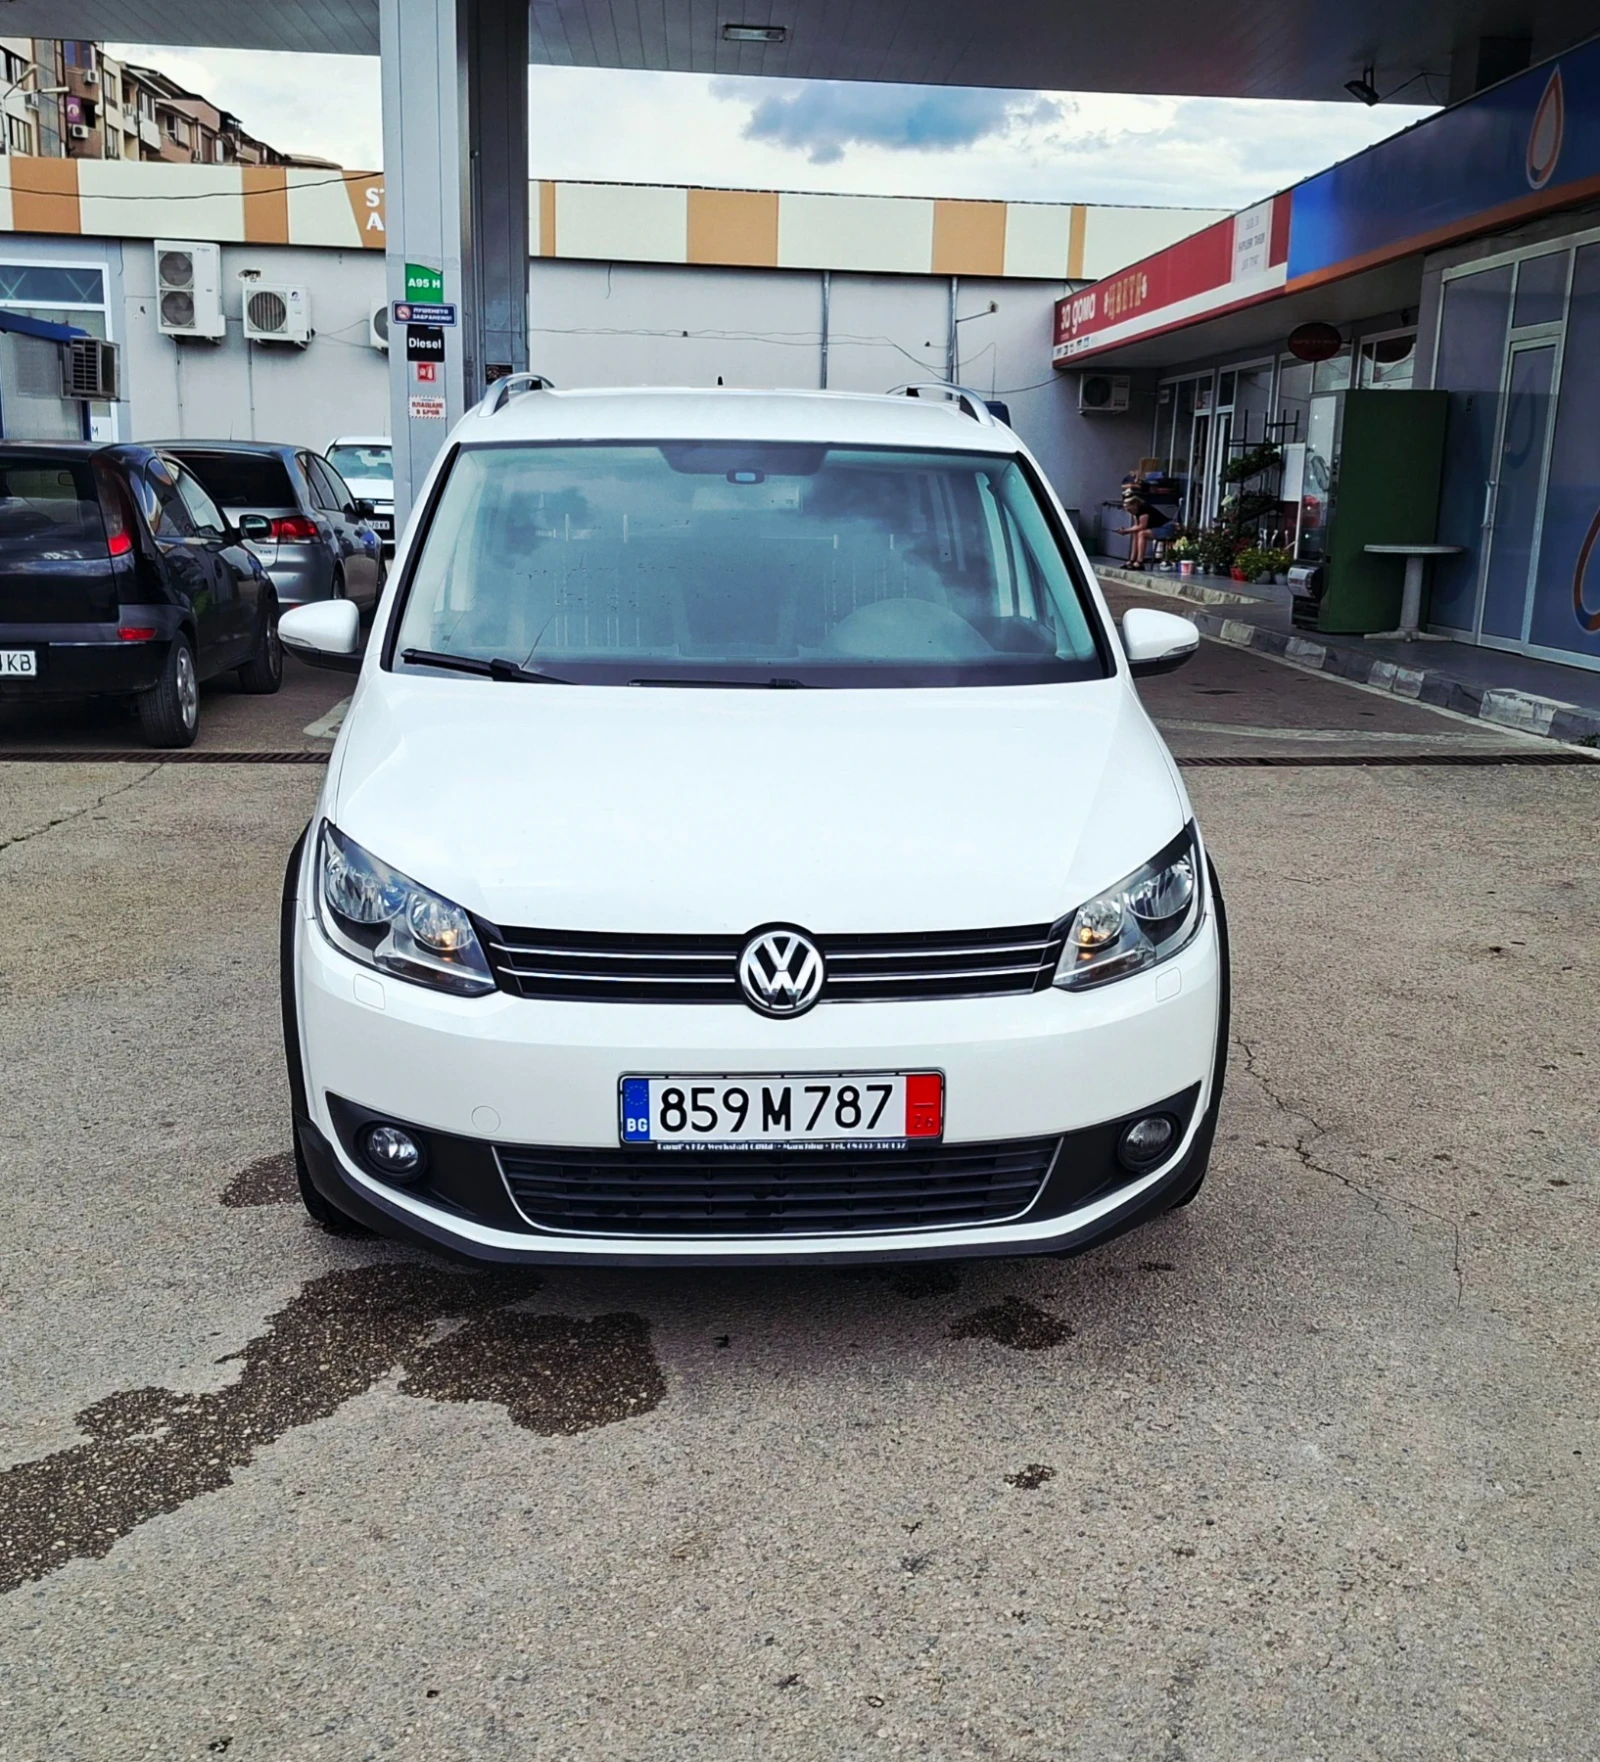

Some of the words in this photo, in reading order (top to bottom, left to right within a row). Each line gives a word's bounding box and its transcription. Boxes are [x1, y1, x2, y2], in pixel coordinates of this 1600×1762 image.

[365, 187, 385, 207] S
[408, 278, 430, 288] A95
[408, 338, 442, 349] Diesel
[626, 1118, 648, 1132] BG
[659, 1087, 750, 1133] 859
[762, 1086, 791, 1132] M
[804, 1084, 893, 1131] 787
